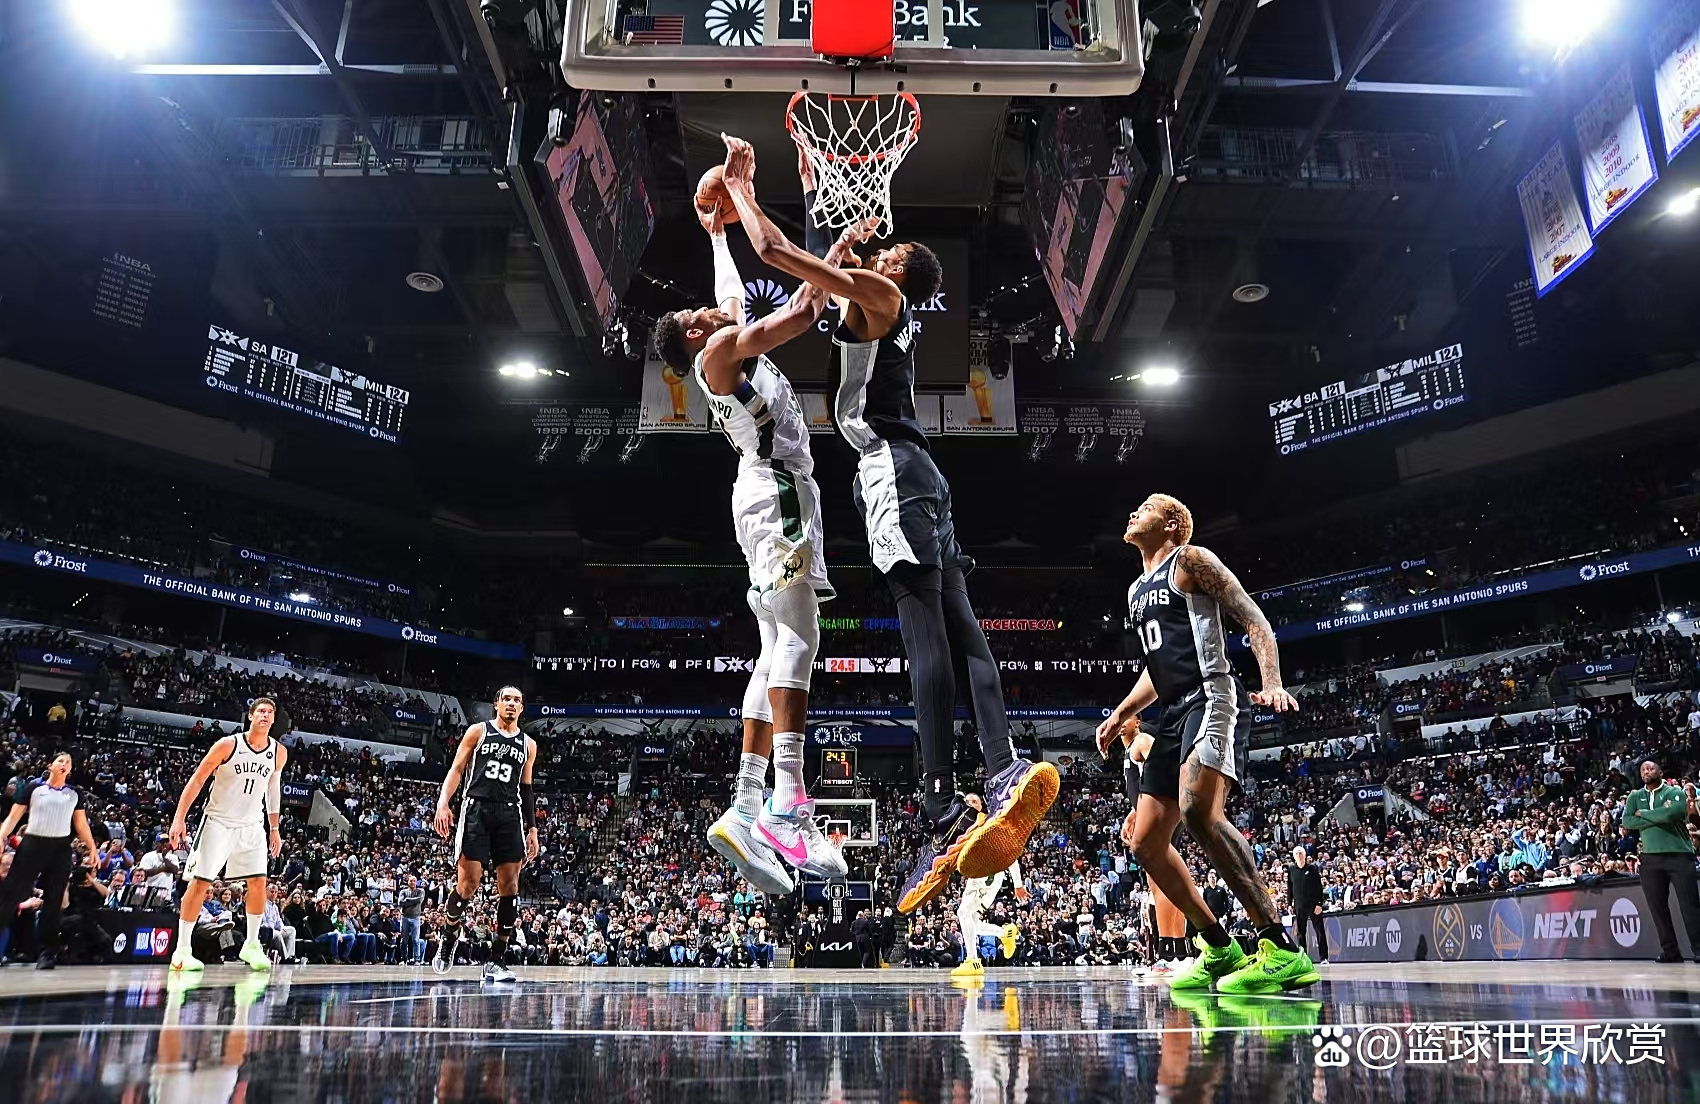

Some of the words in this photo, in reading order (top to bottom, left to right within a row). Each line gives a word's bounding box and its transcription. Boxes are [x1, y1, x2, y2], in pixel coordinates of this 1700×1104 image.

[252, 341, 267, 355] SA
[276, 349, 293, 364] 121
[1412, 354, 1437, 369] MIL
[1439, 346, 1459, 361] 124
[218, 380, 239, 394] Frost
[365, 380, 386, 394] MIL
[389, 387, 407, 402] 124
[1304, 392, 1319, 404] SA
[1325, 383, 1340, 398] 121
[1444, 395, 1465, 407] Frost
[543, 407, 568, 415] NBA
[585, 407, 610, 415] NBA
[1117, 408, 1141, 416] NBA
[575, 427, 610, 435] 2003
[1023, 426, 1058, 434] 2007
[1068, 426, 1104, 434] 2013
[1109, 427, 1144, 436] 2014
[380, 430, 397, 443] Frost
[1290, 441, 1308, 452] Frost
[250, 552, 266, 562] Frost
[1410, 558, 1426, 567] Frost
[54, 555, 87, 573] Frost
[1598, 561, 1630, 576] Frost
[143, 574, 162, 586] THE
[165, 579, 208, 596] OFFICIAL
[211, 588, 237, 602] BANK
[239, 594, 251, 603] OF
[254, 597, 271, 608] THE
[274, 601, 292, 613] SAN
[294, 606, 331, 621] ANTONIO
[333, 613, 362, 628] SPURS
[1316, 620, 1331, 631] THE
[1333, 612, 1371, 627] OFFICIAL
[1373, 607, 1396, 619] BANK
[1398, 604, 1410, 614] OF
[1412, 600, 1429, 611] THE
[1432, 596, 1450, 608] SAN
[1453, 587, 1493, 605] ANTONIO
[1495, 580, 1528, 595] SPURS
[415, 630, 437, 644] Frost
[1137, 619, 1163, 656] 10
[53, 655, 72, 665] Frost
[600, 659, 616, 668] TO
[631, 659, 660, 669] FG%
[685, 660, 702, 669] PF
[813, 661, 824, 670] TH
[830, 660, 855, 672] 24.5
[1000, 661, 1028, 670] FG%
[1051, 661, 1069, 670] TO
[1071, 661, 1076, 671] 2
[1595, 663, 1613, 671] Frost
[550, 707, 566, 715] Frost
[1405, 703, 1420, 712] Frost
[403, 711, 416, 720] Frost
[1262, 713, 1274, 722] Frost
[826, 751, 846, 762] 24.3
[234, 761, 271, 778] BUCKS
[484, 759, 513, 783] 33
[840, 761, 849, 776] 7
[243, 778, 255, 795] 11
[292, 787, 309, 796] Frost
[1367, 789, 1384, 798] Frost
[832, 900, 842, 908] GET
[832, 907, 842, 916] THE
[832, 915, 843, 924] APP
[1534, 909, 1597, 940] NEXT
[1610, 914, 1640, 934] TNT
[1346, 926, 1380, 948] NEXT
[1386, 930, 1401, 944] TNT
[1470, 924, 1482, 940] VS
[820, 941, 853, 951] KIA
